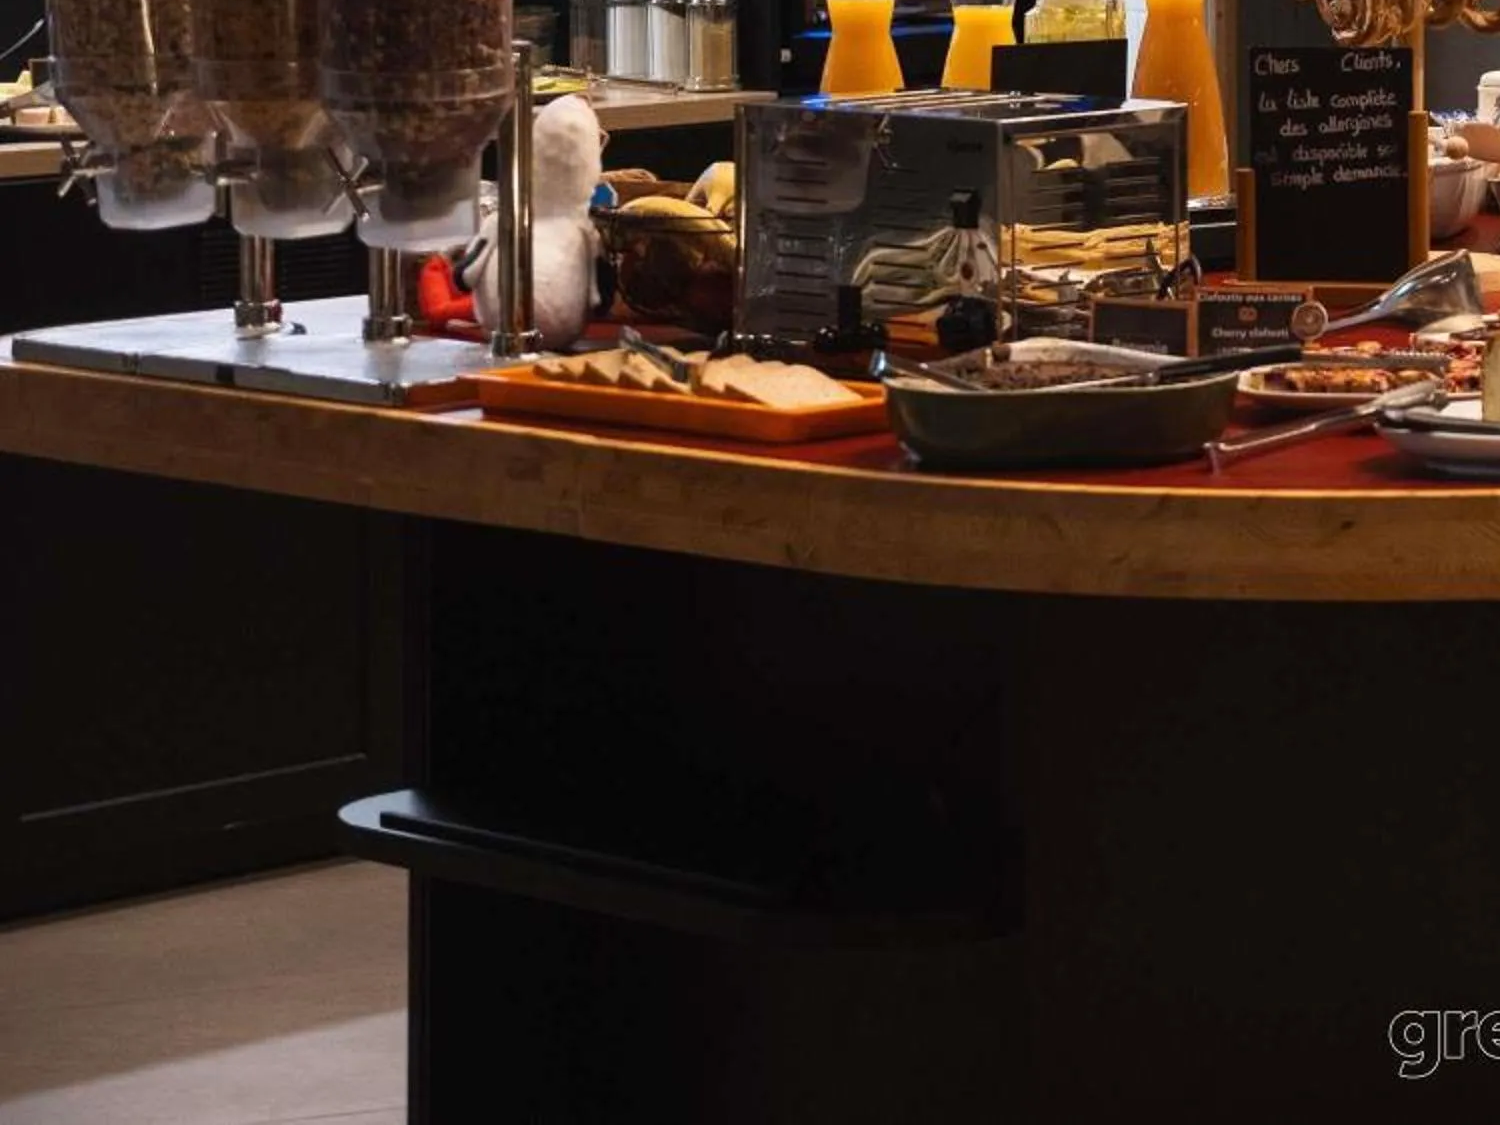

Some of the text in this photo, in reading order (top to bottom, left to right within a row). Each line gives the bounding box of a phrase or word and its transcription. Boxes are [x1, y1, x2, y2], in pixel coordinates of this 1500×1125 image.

[1255, 52, 1300, 75] Chers
[1279, 118, 1308, 137] des
[1211, 327, 1247, 339] Cherry
